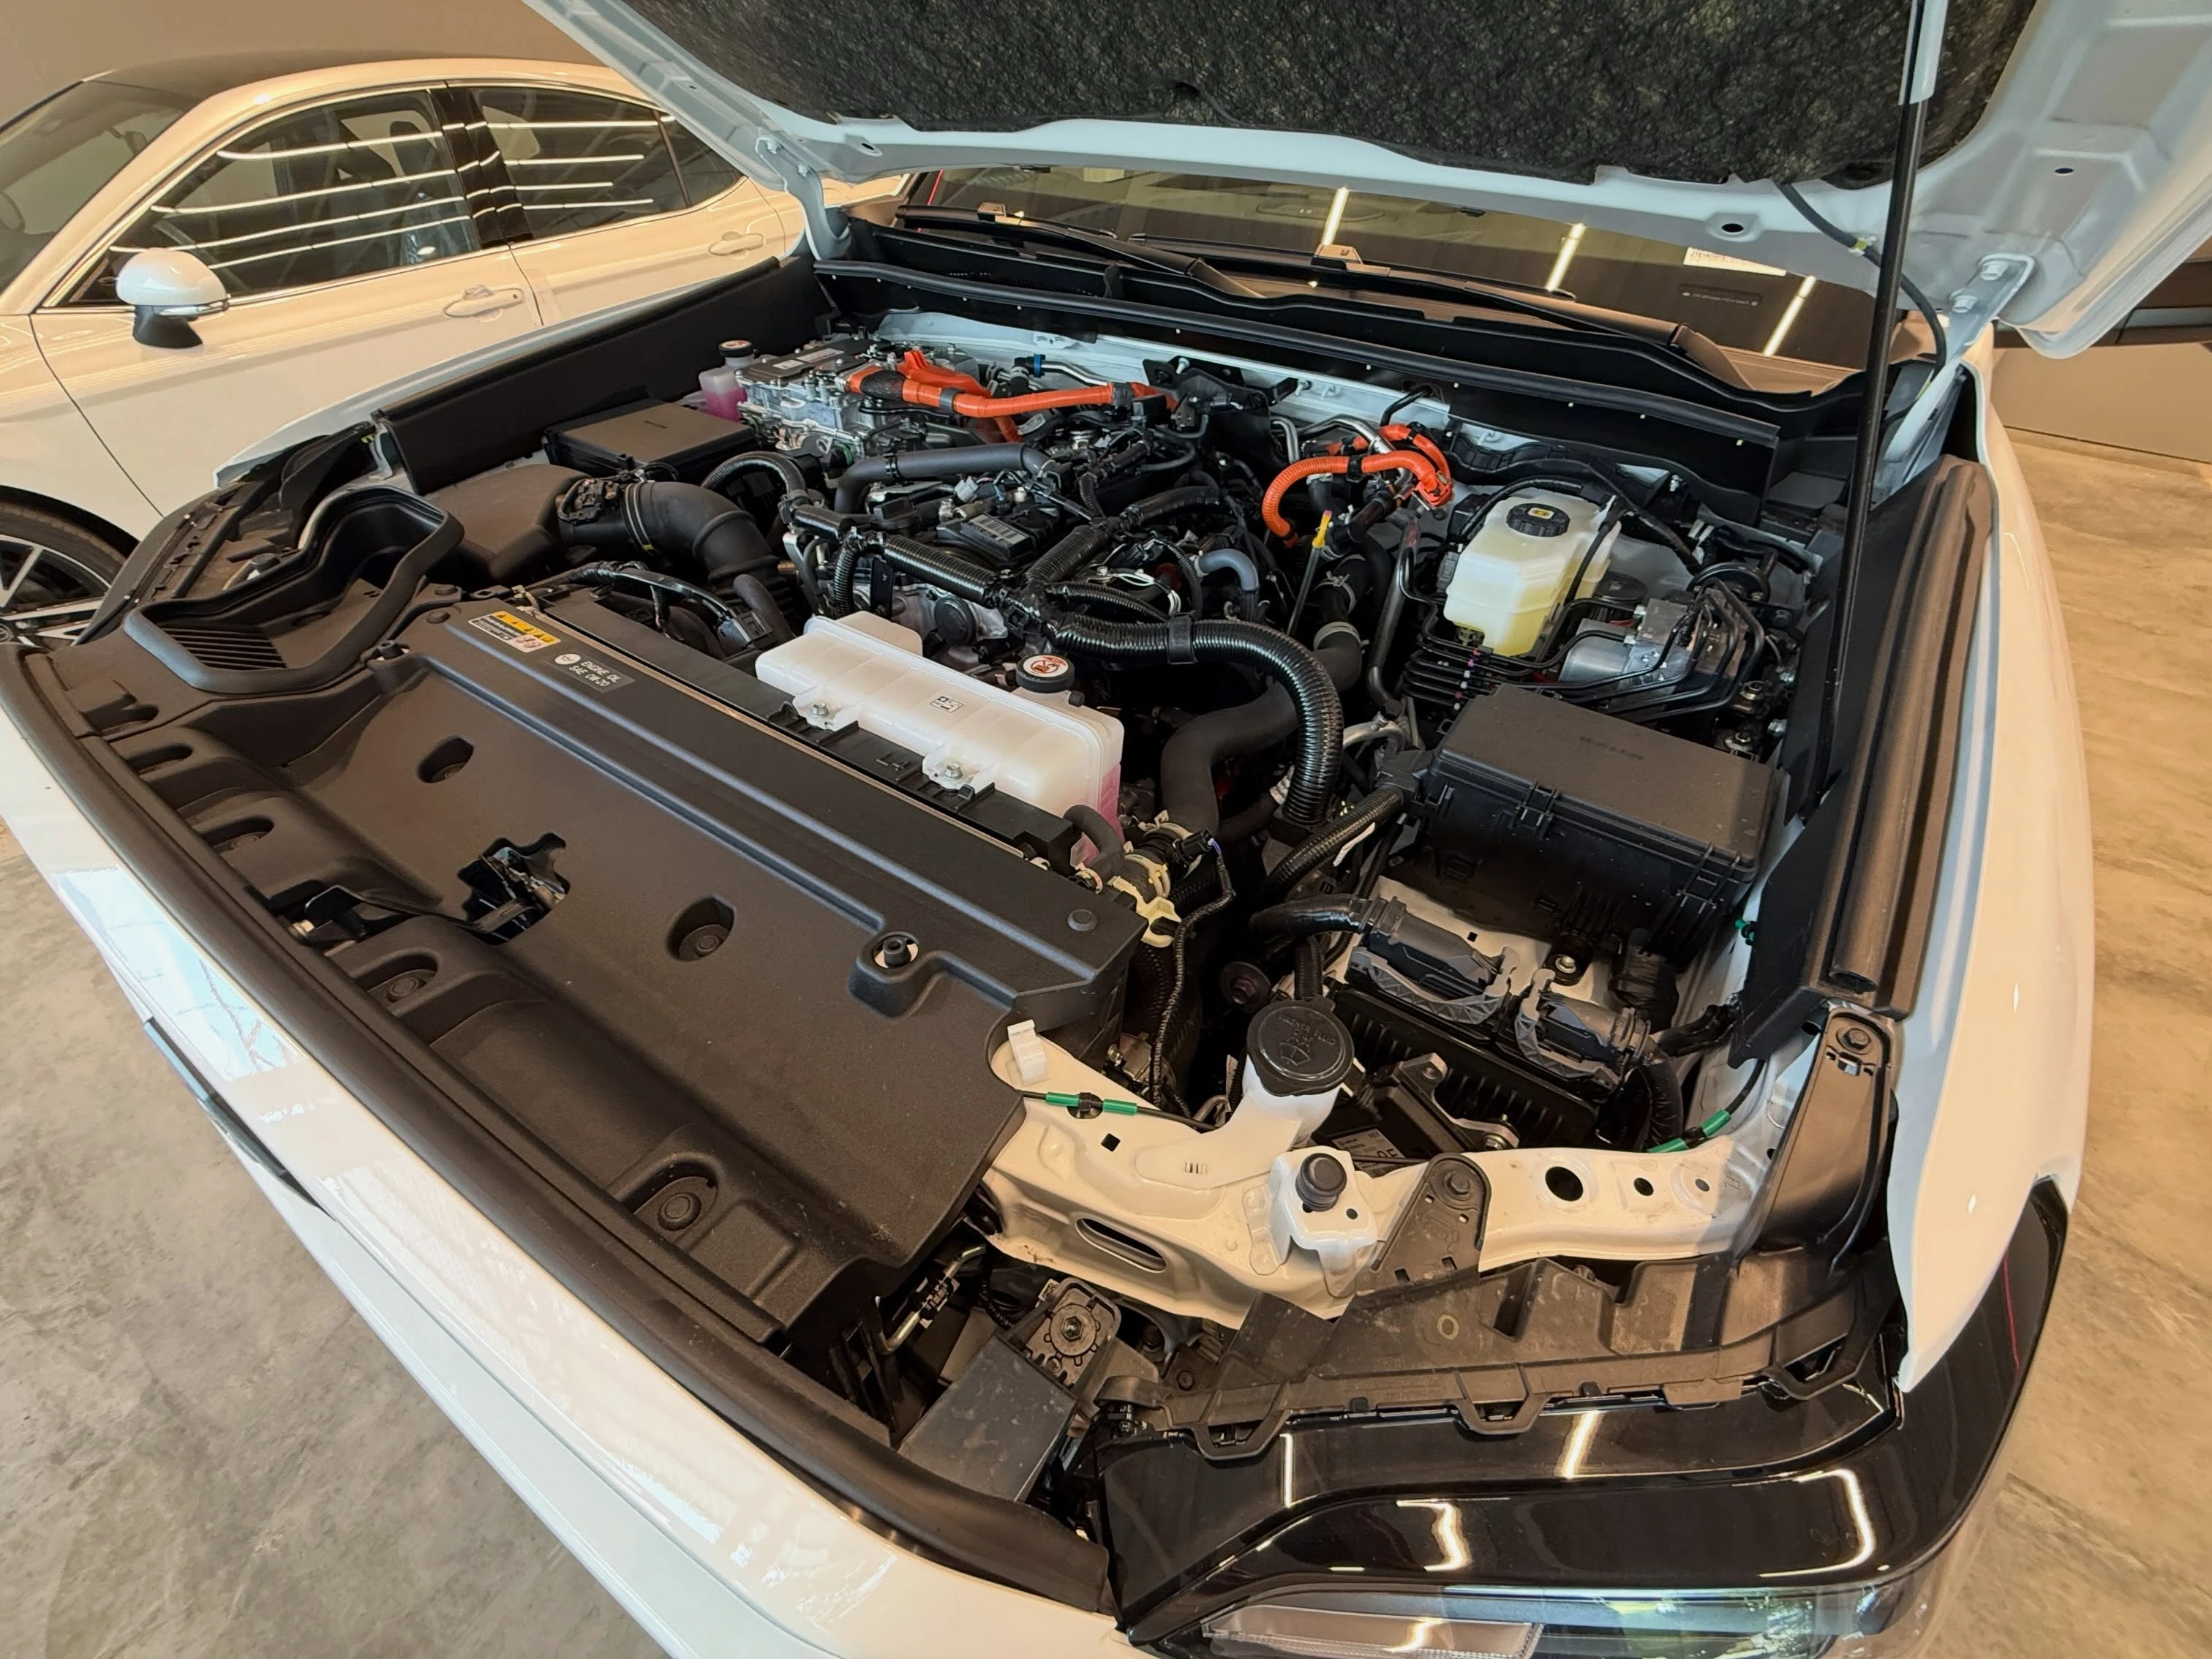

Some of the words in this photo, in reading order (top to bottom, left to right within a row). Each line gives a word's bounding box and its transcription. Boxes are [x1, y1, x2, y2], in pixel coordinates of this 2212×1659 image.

[569, 665, 588, 675] SAE
[581, 661, 610, 676] ENGINE
[607, 674, 621, 683] OIL
[1279, 1014, 1311, 1032] WASHER
[1313, 1030, 1336, 1045] FLUID
